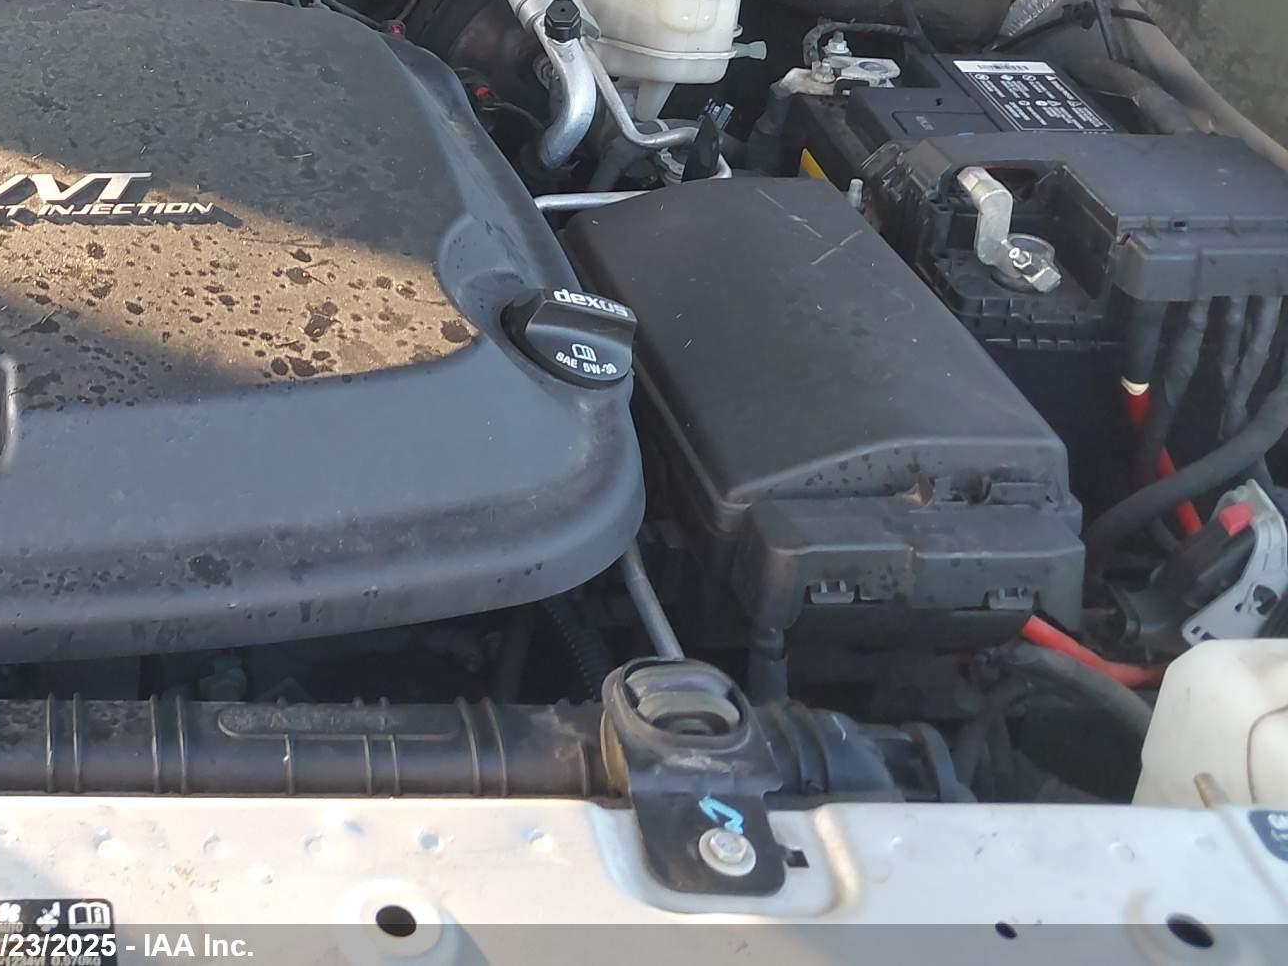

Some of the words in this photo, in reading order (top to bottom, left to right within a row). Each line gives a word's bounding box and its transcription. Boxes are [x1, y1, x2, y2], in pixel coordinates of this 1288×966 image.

[37, 201, 213, 216] INJECTION
[555, 351, 578, 369] SAE
[582, 361, 617, 375] 5W-30
